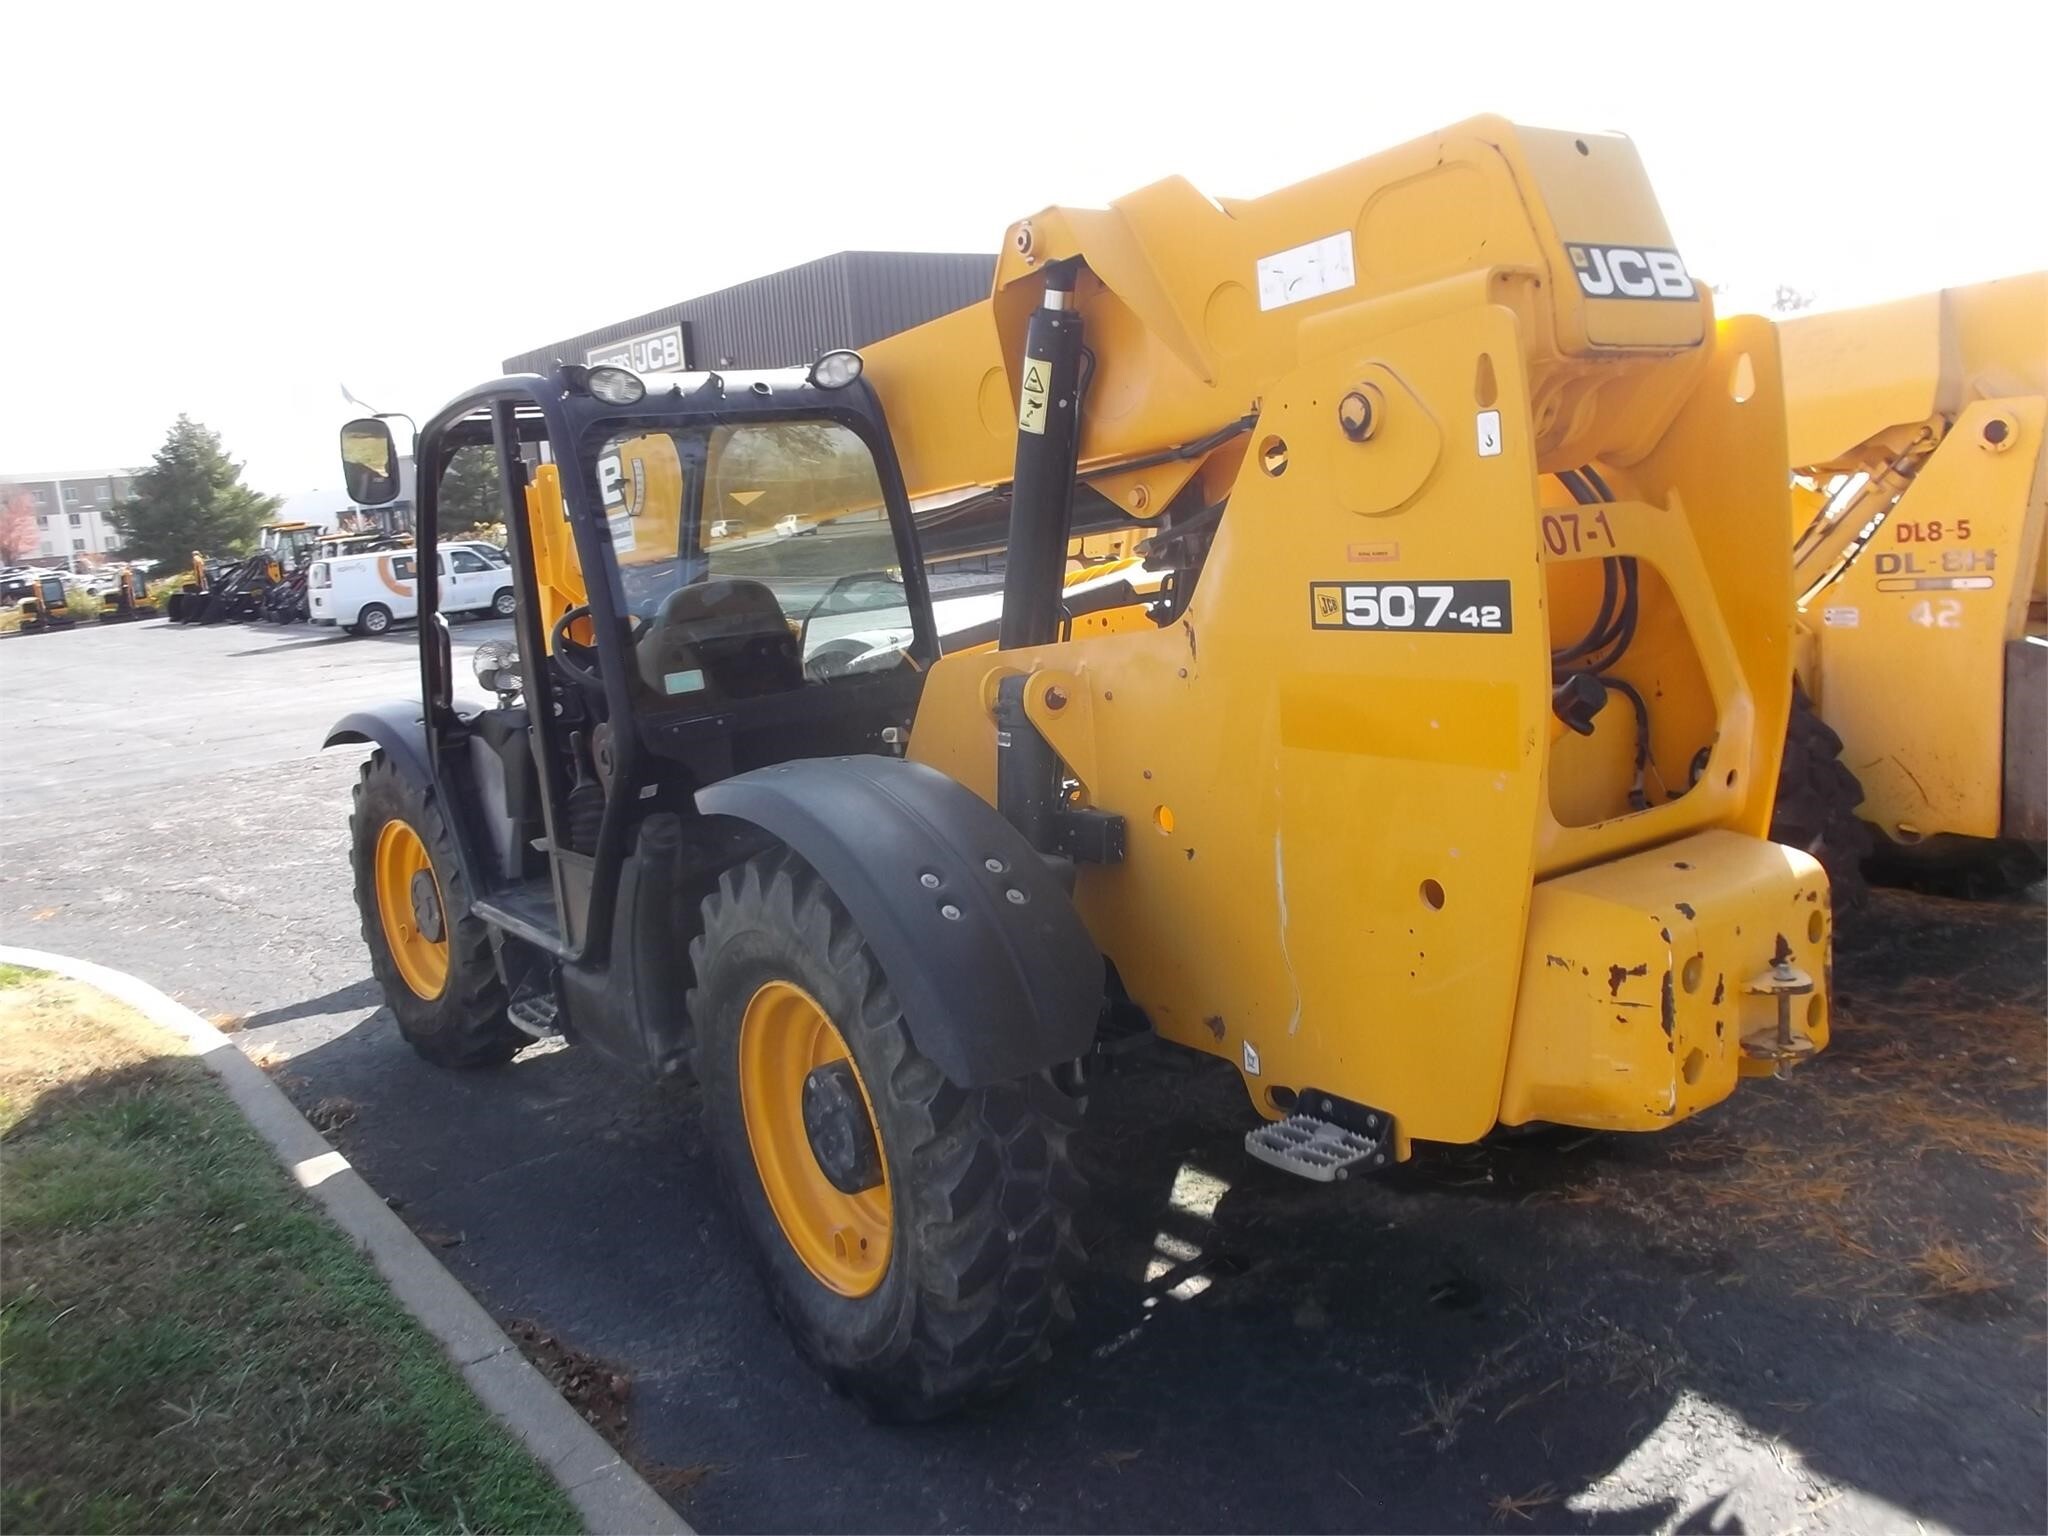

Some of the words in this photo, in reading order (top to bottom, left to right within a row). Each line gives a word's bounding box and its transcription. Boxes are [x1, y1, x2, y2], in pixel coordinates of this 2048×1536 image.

[1578, 247, 1695, 298] JCB
[635, 335, 680, 372] JCB
[1542, 510, 1616, 556] 07-1
[1896, 519, 1971, 543] DL8-5
[1321, 597, 1338, 614] JCB
[1345, 586, 1502, 628] 507-42
[1909, 599, 1964, 628] 42
